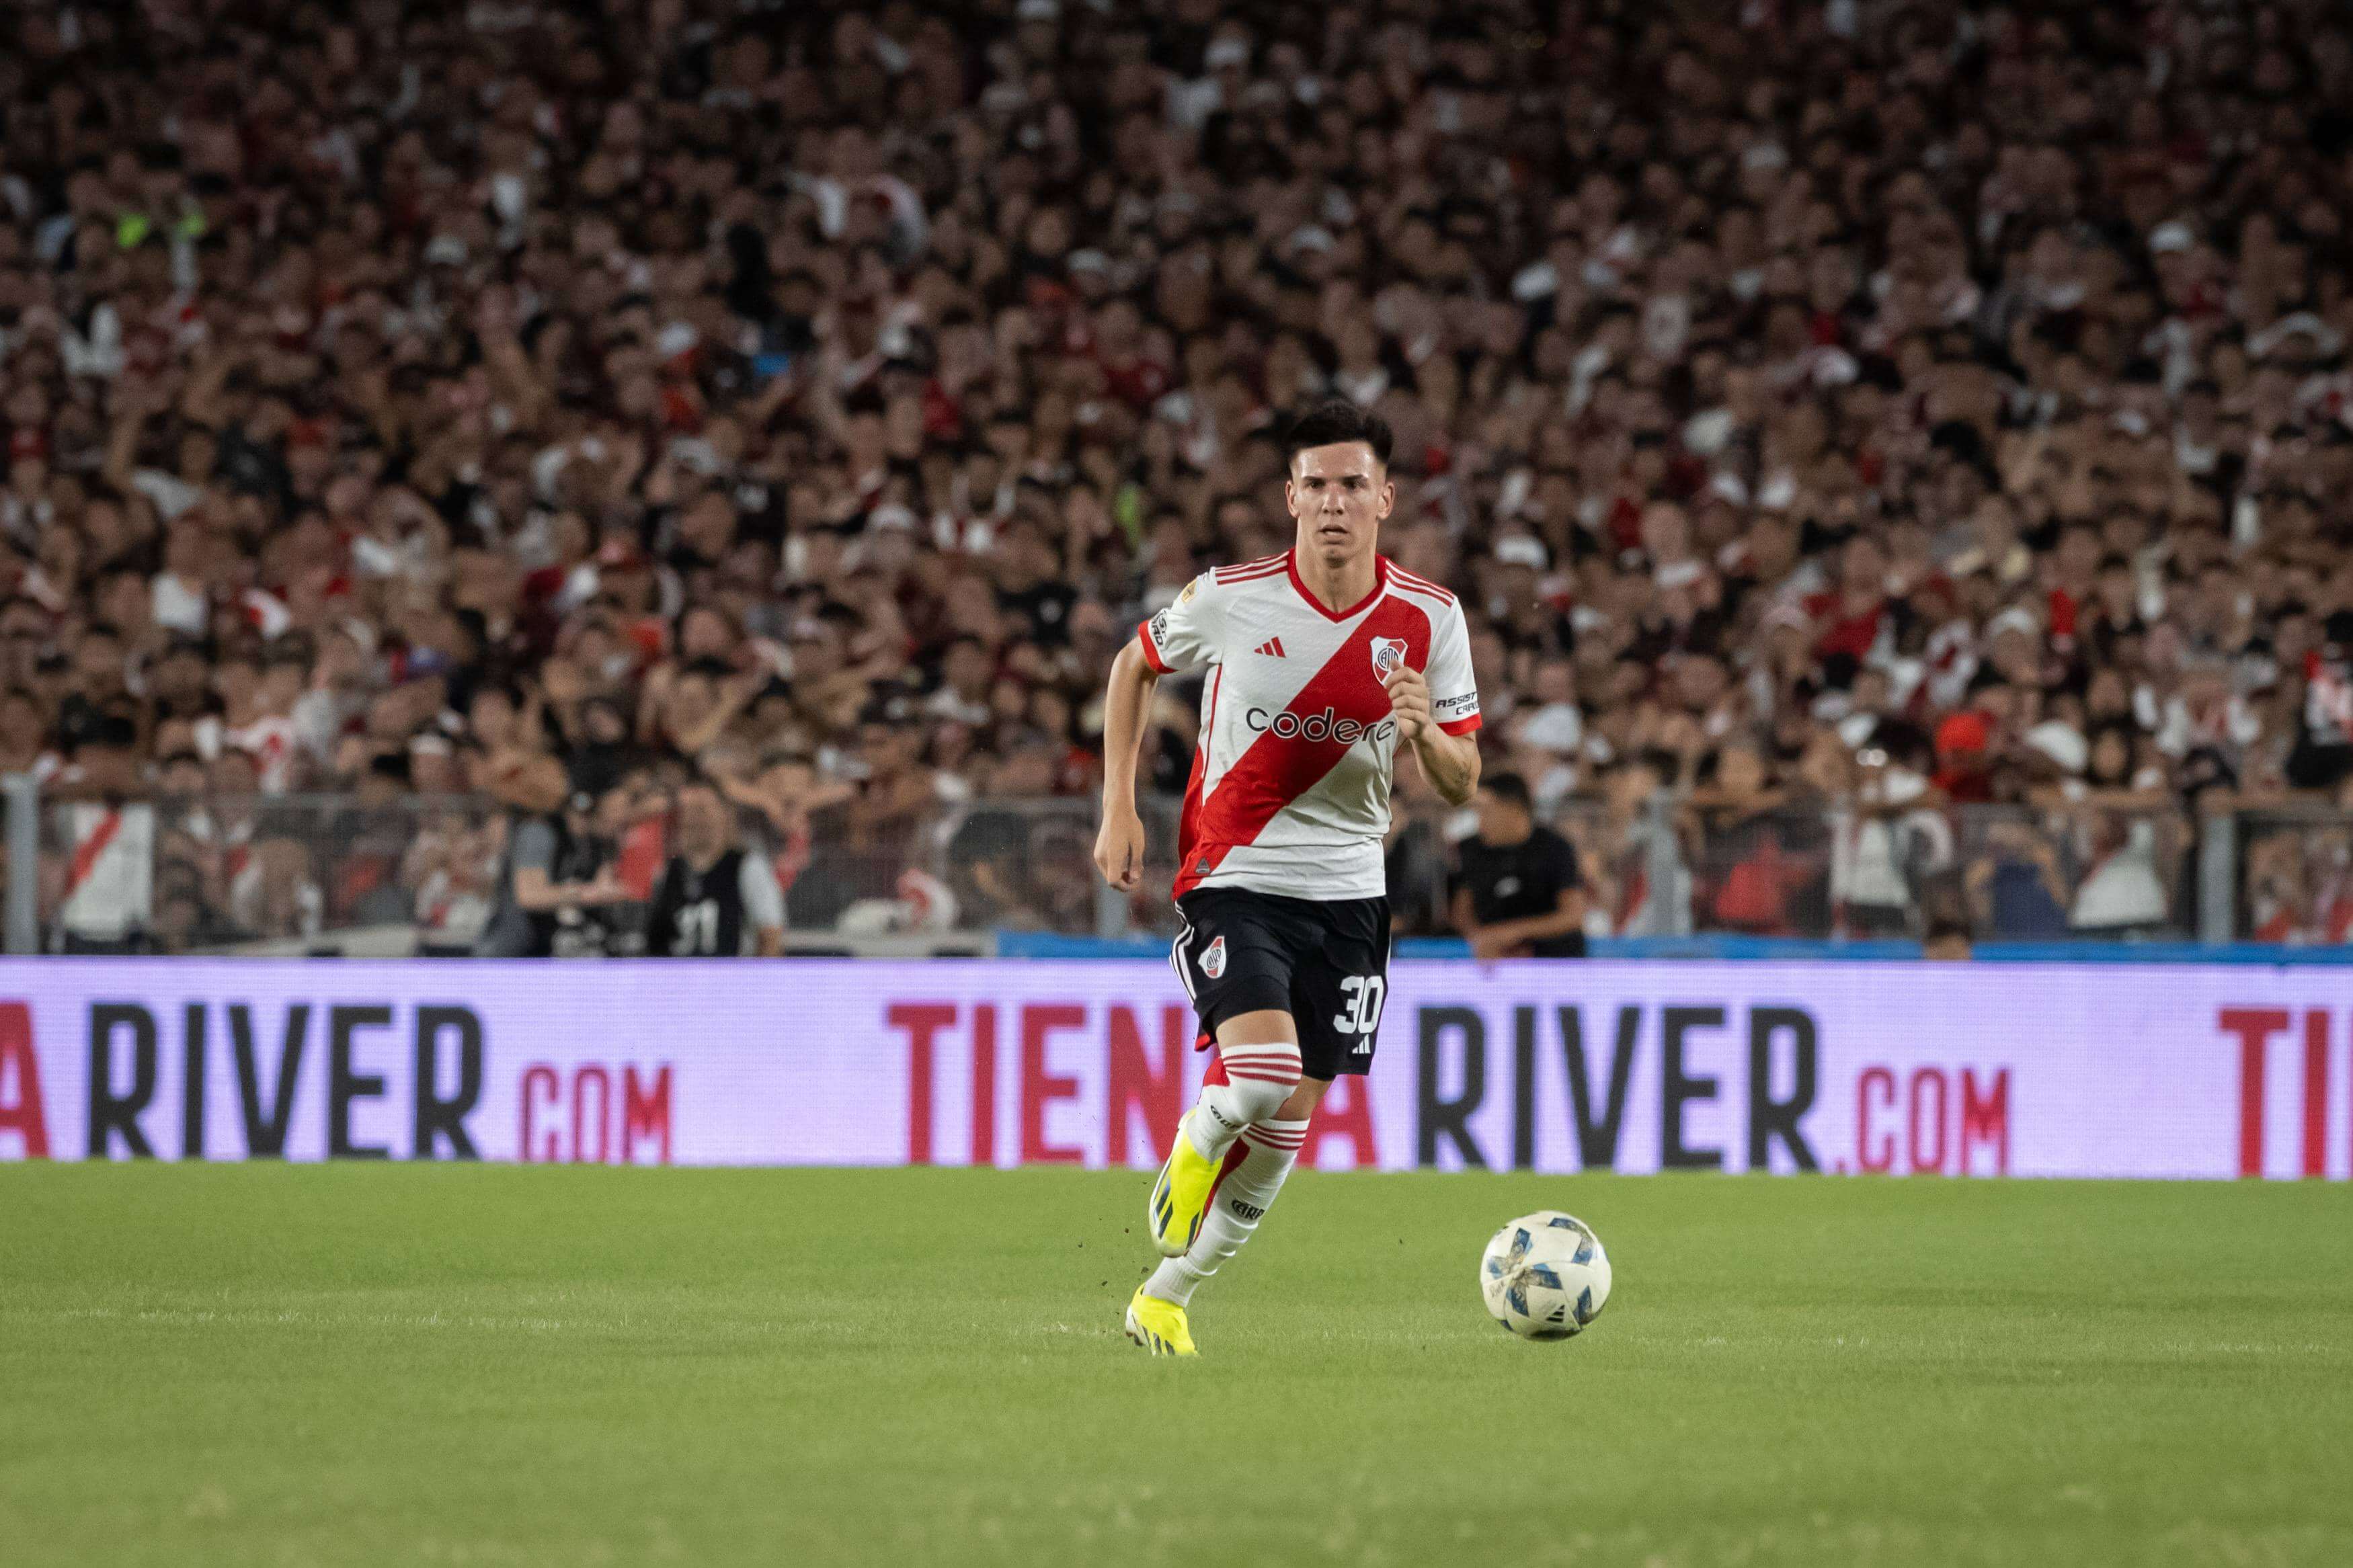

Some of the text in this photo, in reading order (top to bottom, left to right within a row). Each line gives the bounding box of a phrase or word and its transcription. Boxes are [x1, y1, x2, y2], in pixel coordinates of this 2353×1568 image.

[1435, 691, 1477, 708] ASSIST
[1333, 975, 1384, 1034] 30
[889, 1004, 1378, 1169] TIENA
[2220, 1009, 2353, 1178] TI
